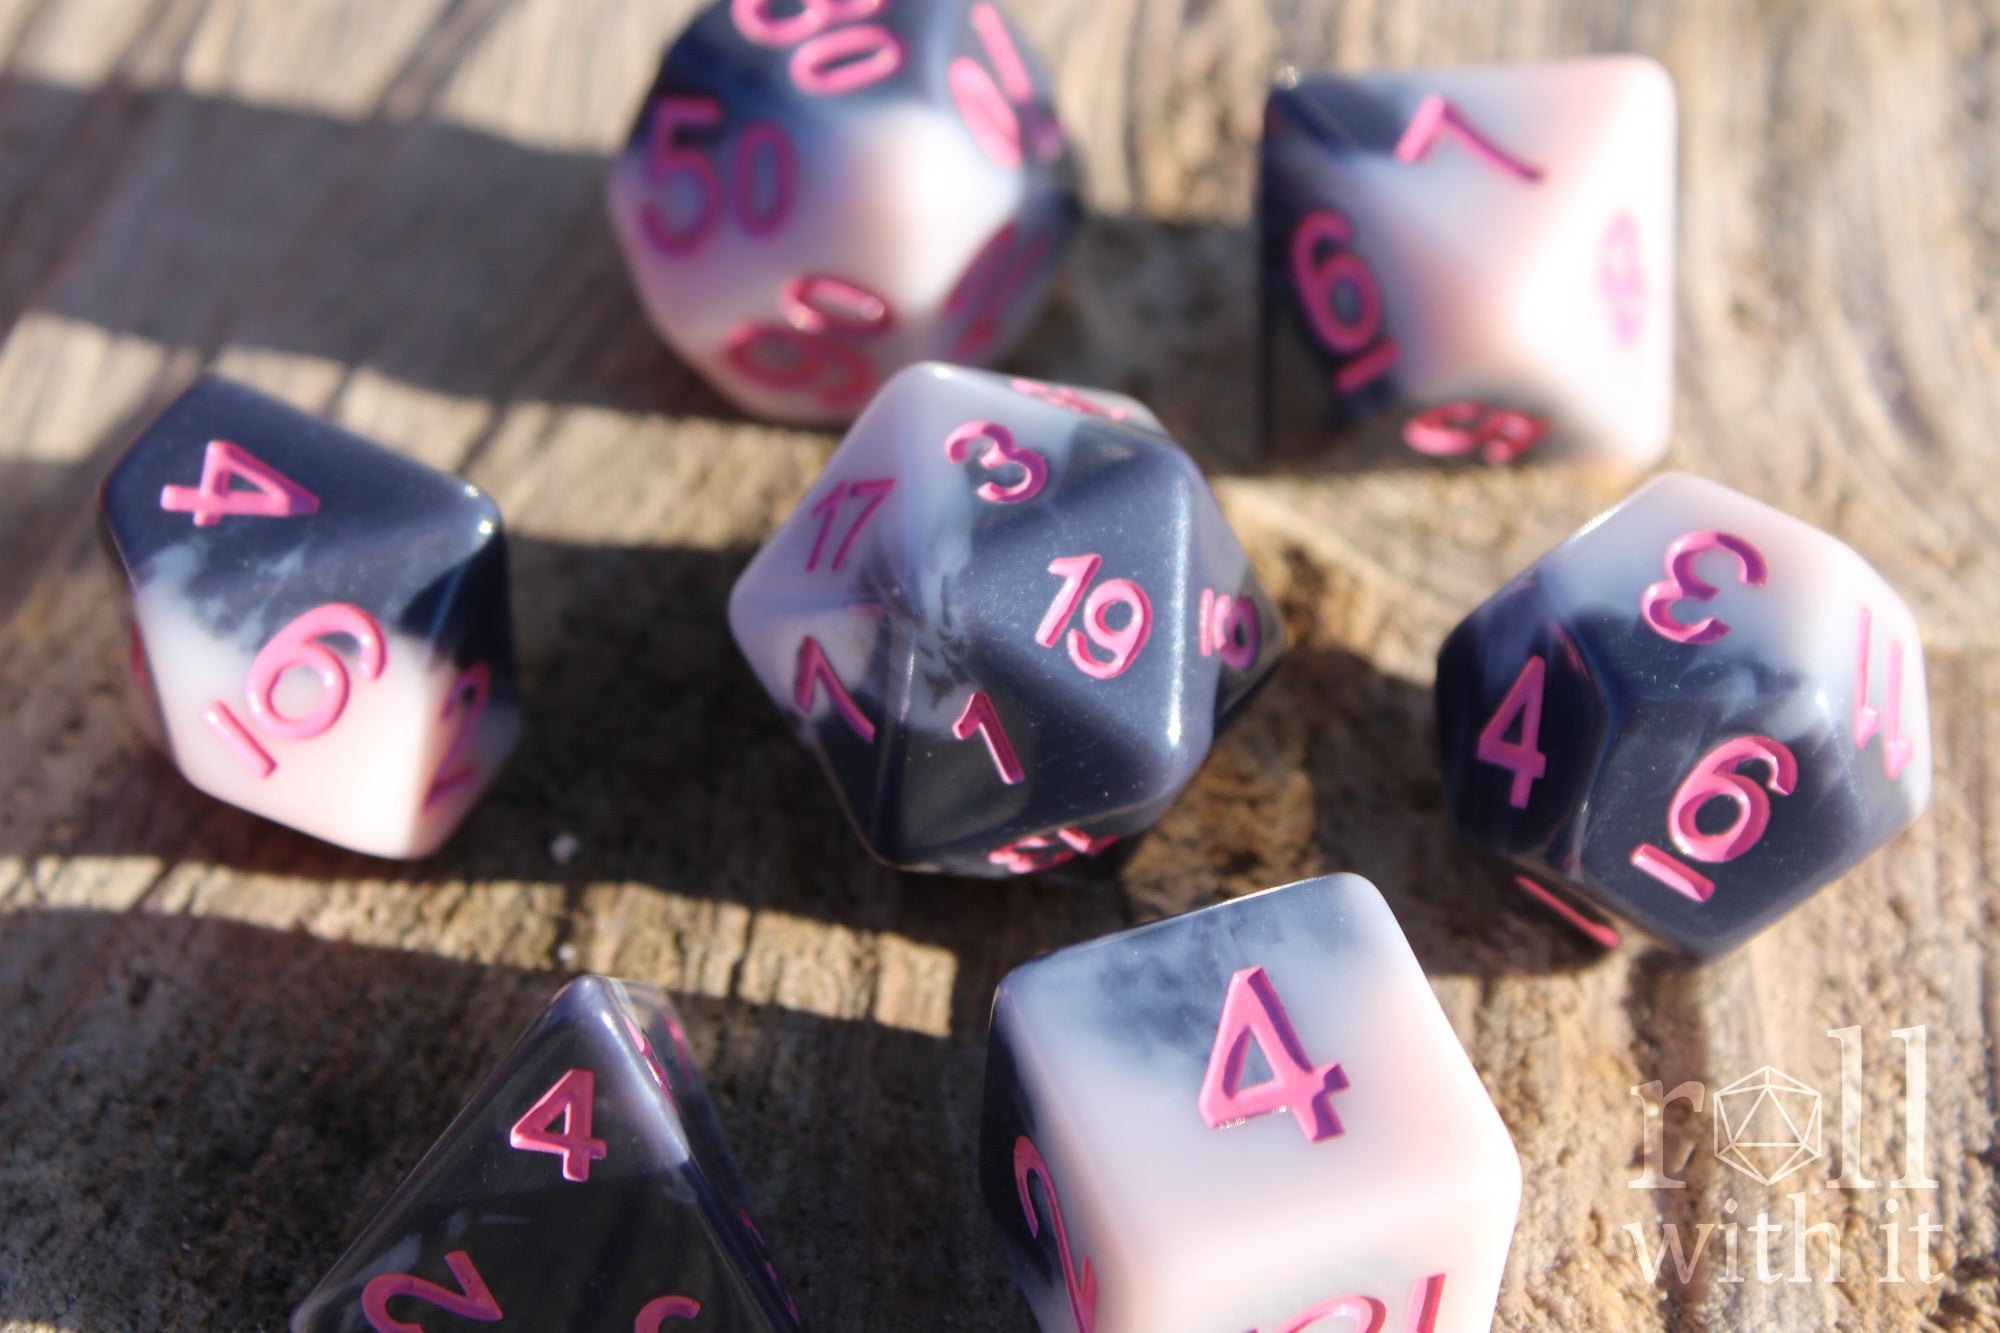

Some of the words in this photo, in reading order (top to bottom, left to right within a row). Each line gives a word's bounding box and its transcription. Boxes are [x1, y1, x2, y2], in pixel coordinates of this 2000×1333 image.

[640, 97, 798, 260] 50
[160, 440, 321, 526] 4
[944, 421, 1049, 503] 3
[806, 476, 896, 573] 17
[1036, 553, 1153, 679] 19
[1640, 530, 1770, 645] 3
[952, 691, 1025, 785] 1
[1476, 655, 1547, 811] 4
[1198, 966, 1351, 1143] 4
[509, 1068, 608, 1183] 4
